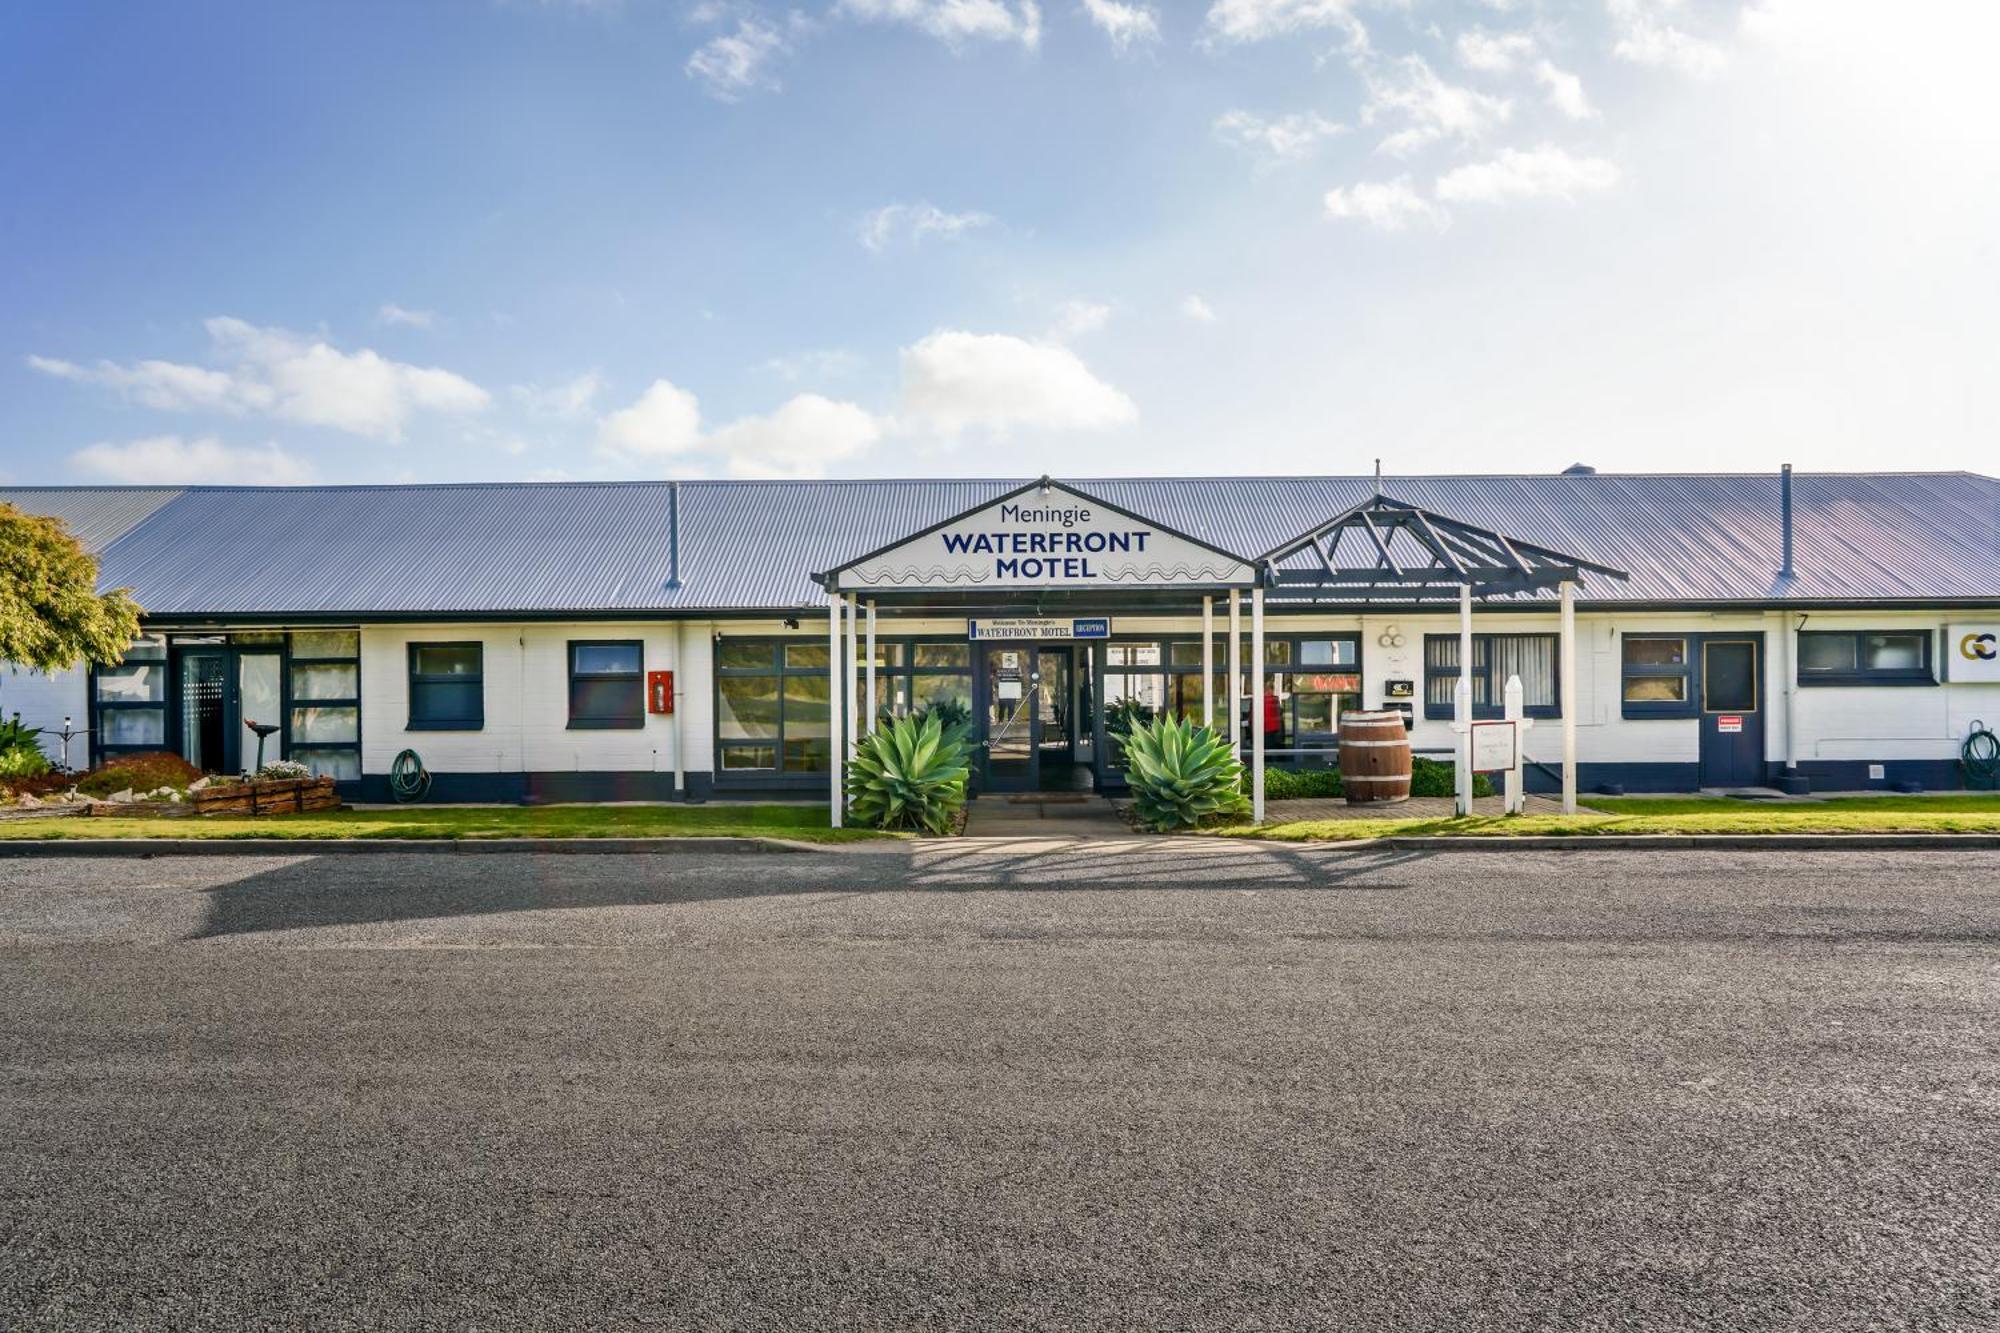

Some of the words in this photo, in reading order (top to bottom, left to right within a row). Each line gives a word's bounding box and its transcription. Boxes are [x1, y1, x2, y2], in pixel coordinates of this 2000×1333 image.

[1001, 505, 1091, 527] Meningie
[942, 532, 1151, 554] WATERFRONT
[997, 558, 1097, 579] MOTEL
[977, 627, 1037, 638] WATERFRONT
[1040, 626, 1071, 637] MOTEL
